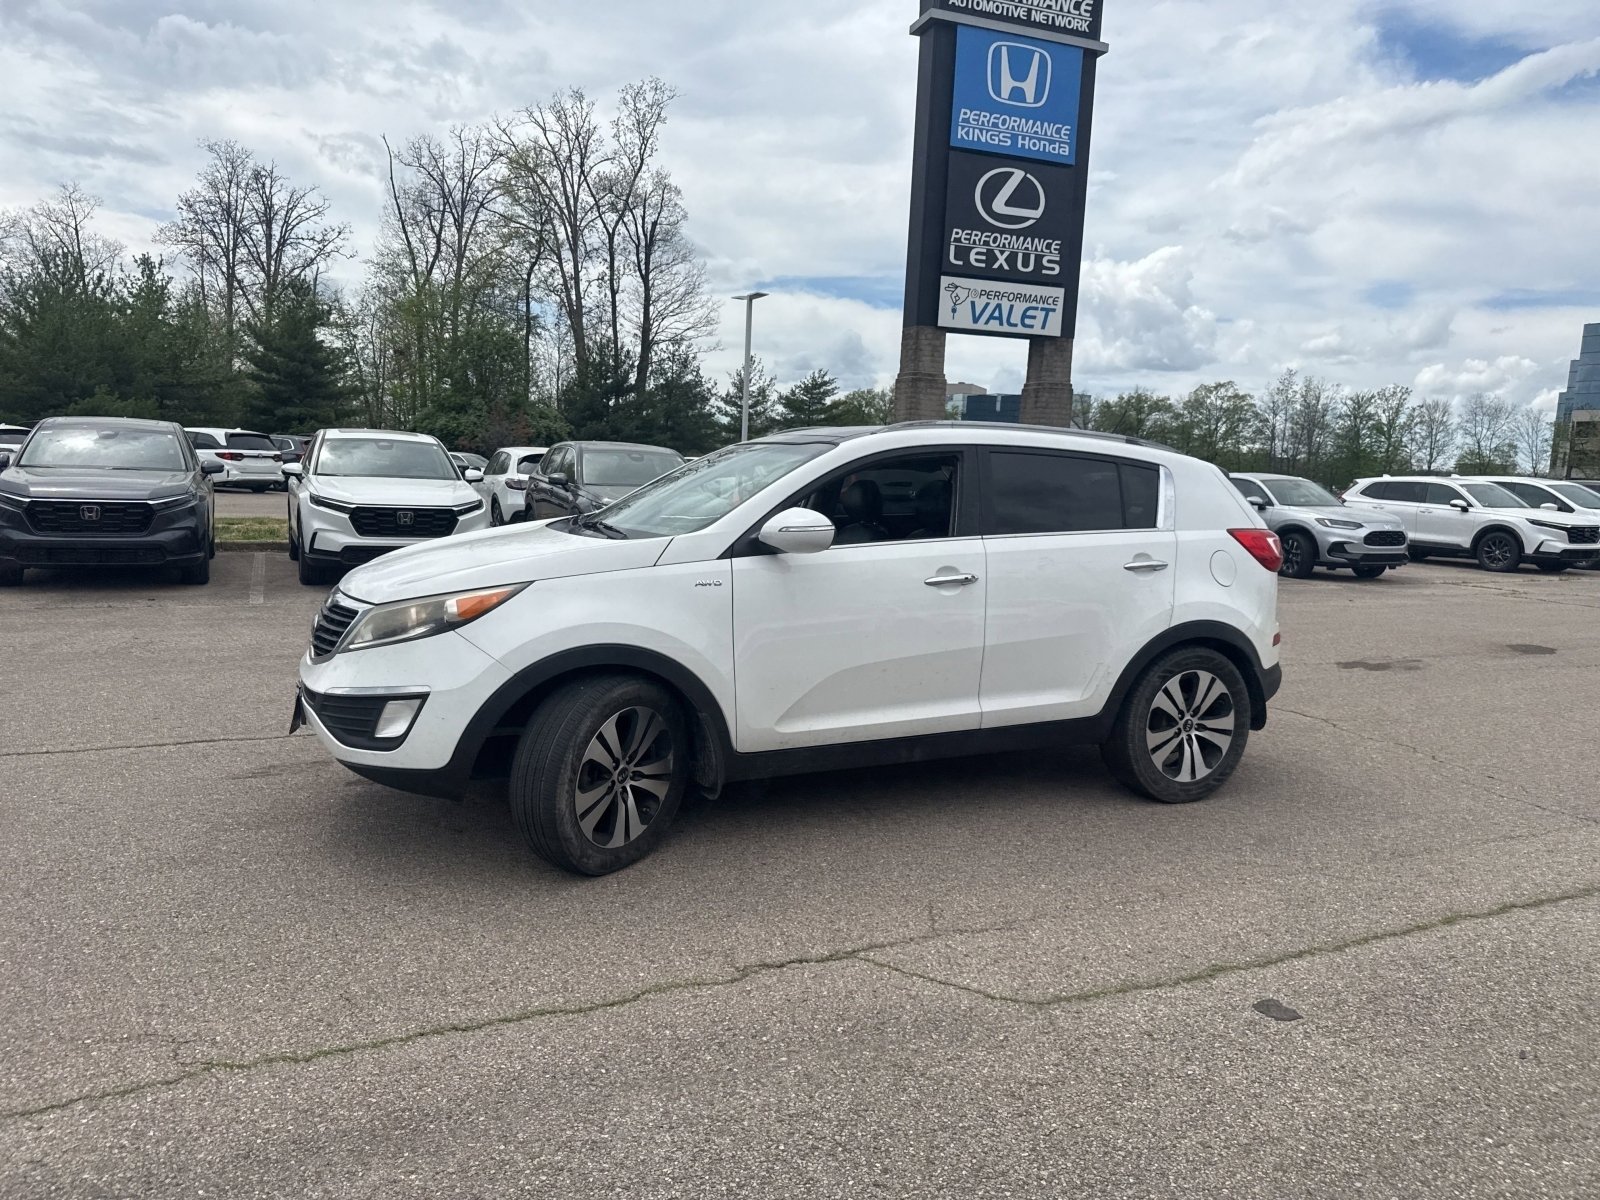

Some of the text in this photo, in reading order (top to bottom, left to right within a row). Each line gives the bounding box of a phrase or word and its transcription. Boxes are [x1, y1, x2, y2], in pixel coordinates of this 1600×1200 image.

[1014, 0, 1093, 17] ANCE
[1031, 10, 1090, 32] NETWORK
[958, 108, 1071, 139] PERFORMANCE
[957, 126, 1069, 156] KINGS Honda
[950, 228, 1062, 254] PERFORMANCE
[949, 244, 1061, 275] LEXUS
[979, 289, 1059, 306] PERFORMANCE
[970, 301, 1057, 330] VALET
[695, 579, 722, 587] AWD
